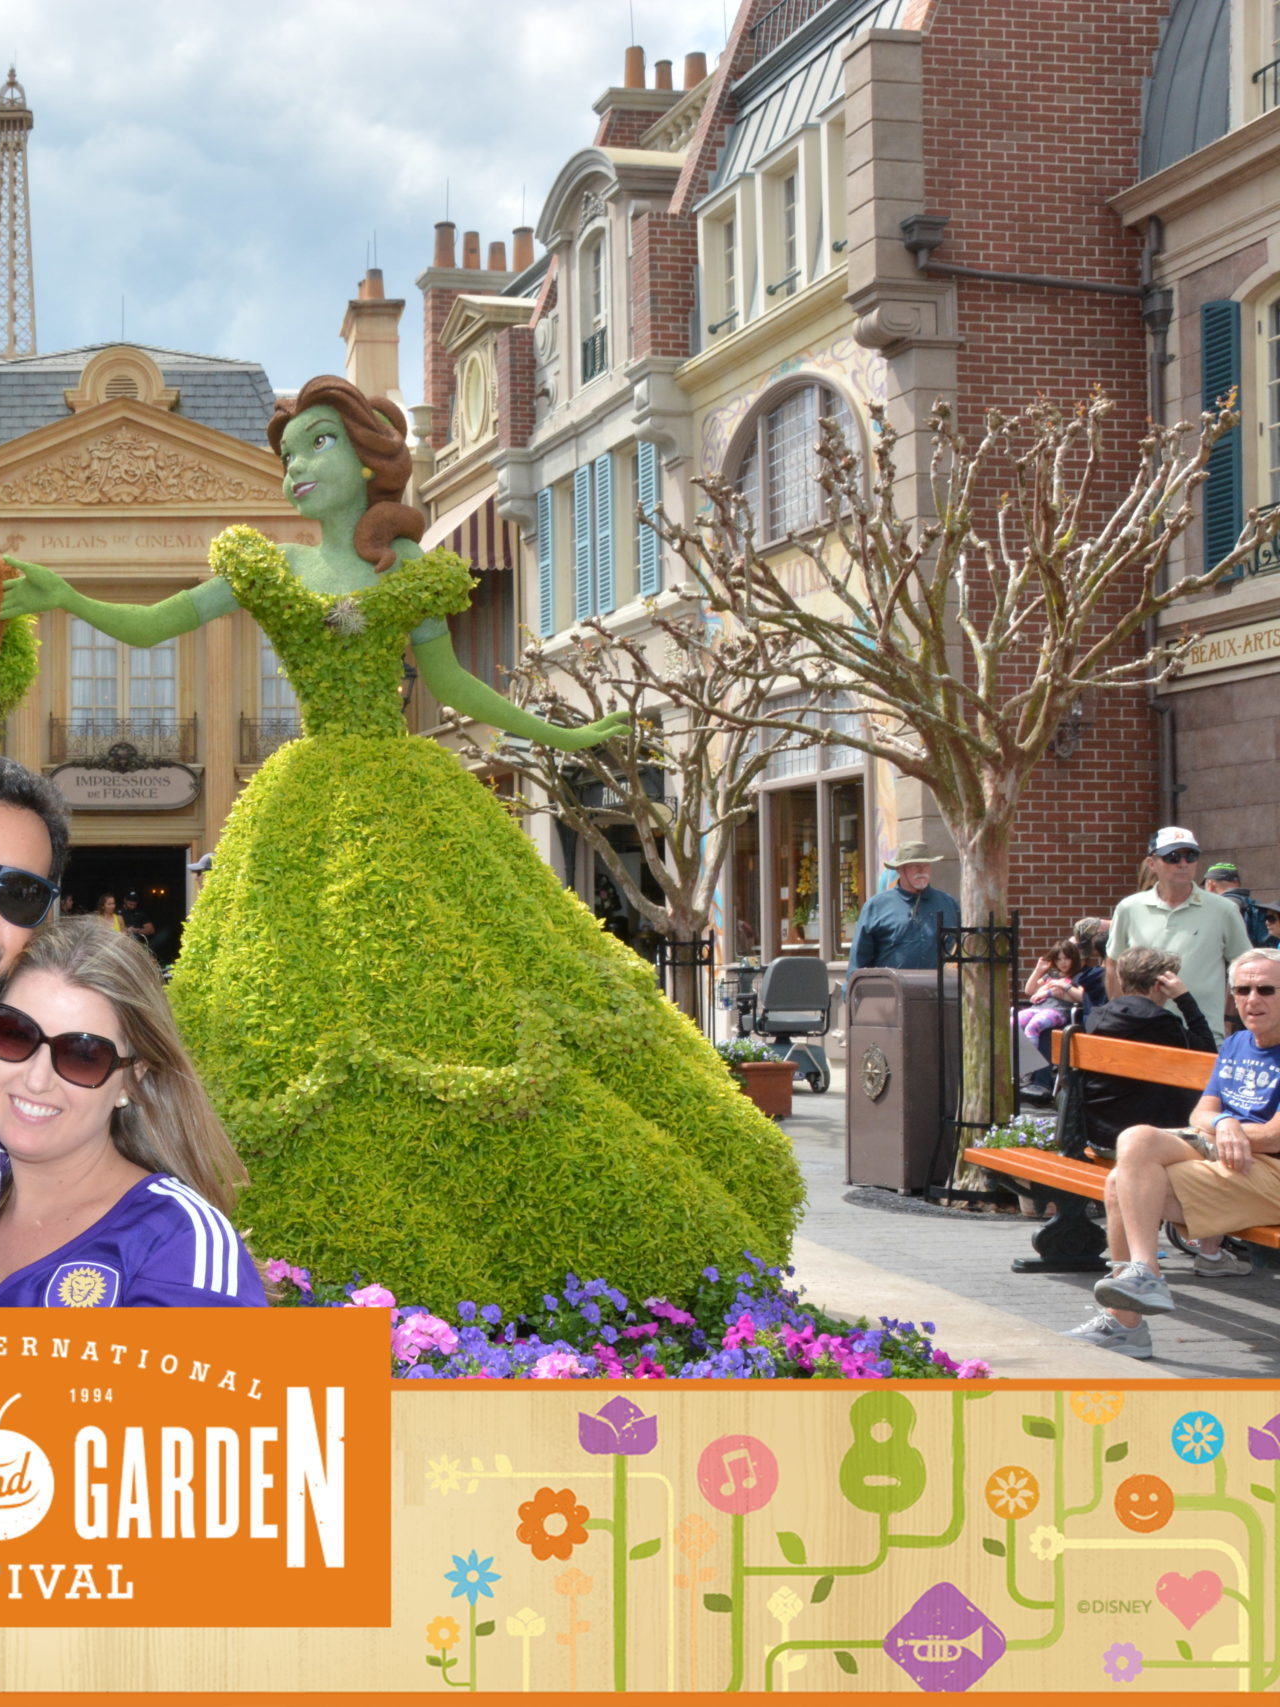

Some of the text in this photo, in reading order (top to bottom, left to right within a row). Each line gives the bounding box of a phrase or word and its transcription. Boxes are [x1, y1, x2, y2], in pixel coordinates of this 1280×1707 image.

[41, 535, 107, 549] PALAIS
[1191, 628, 1280, 665] BEAUX-ARTS
[75, 775, 171, 787] IMPRESSIONS
[103, 787, 159, 799] FRANCE
